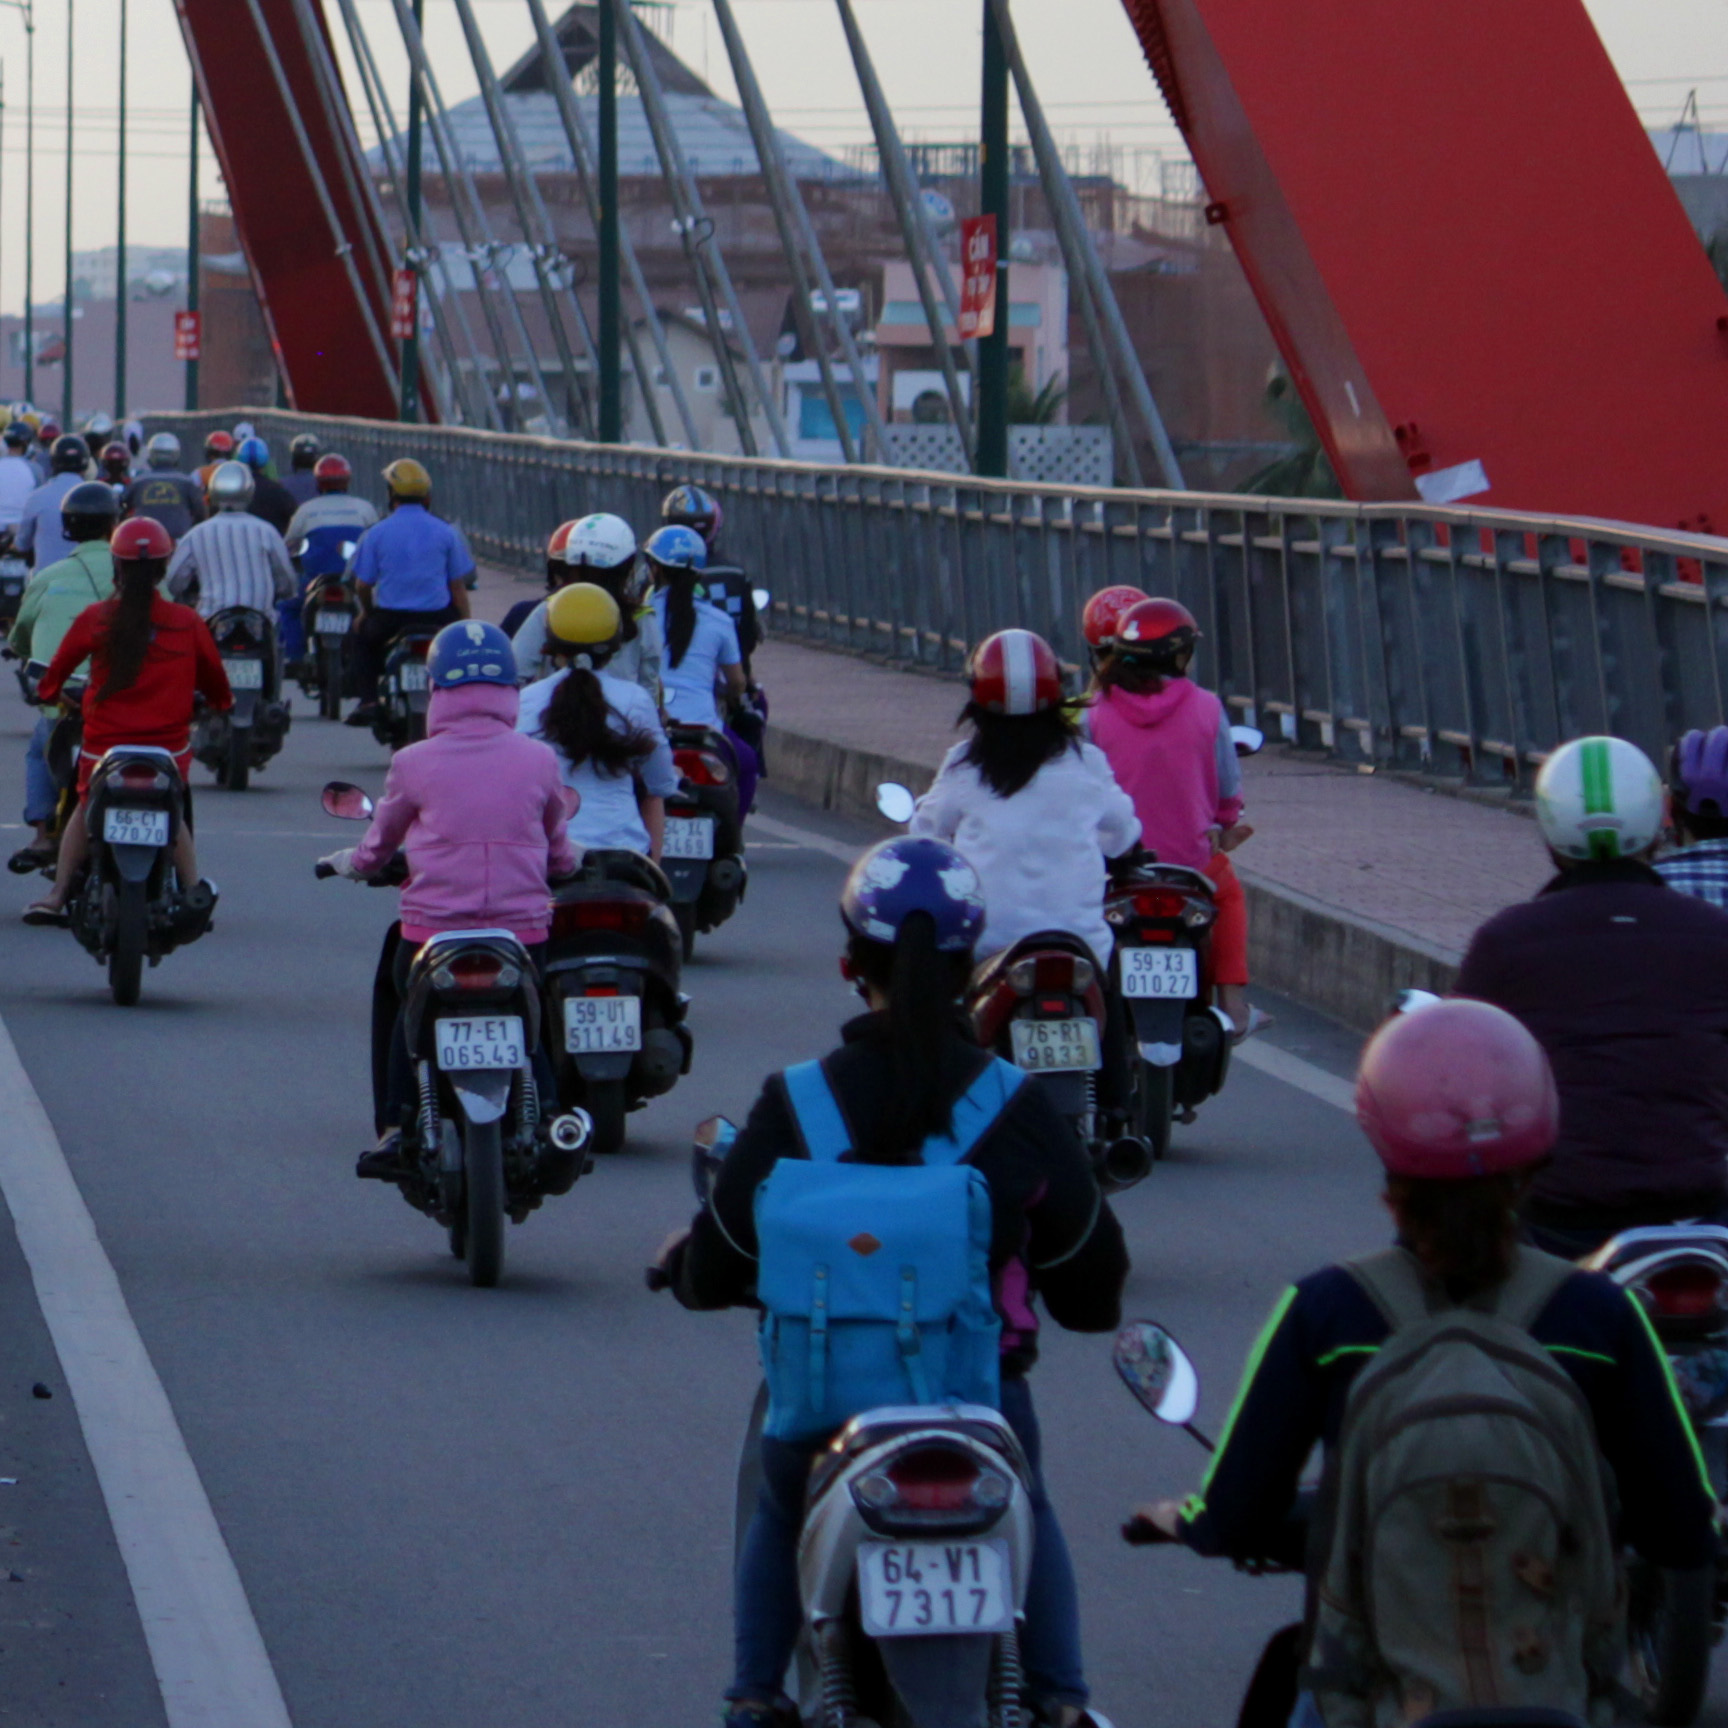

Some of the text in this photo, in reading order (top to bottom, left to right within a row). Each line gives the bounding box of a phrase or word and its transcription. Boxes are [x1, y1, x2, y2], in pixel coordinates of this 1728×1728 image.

[1133, 952, 1183, 972] 59-X3
[1127, 974, 1190, 995] 010.27
[576, 1001, 625, 1024] 59-U1
[449, 1021, 507, 1043] 77-E1
[569, 1026, 635, 1050] 511.49
[1023, 1022, 1081, 1045] 76-R1
[443, 1044, 519, 1067] 065.43
[1027, 1044, 1087, 1067] 9833
[882, 1547, 981, 1584] 64-V1
[885, 1588, 989, 1627] 7317
